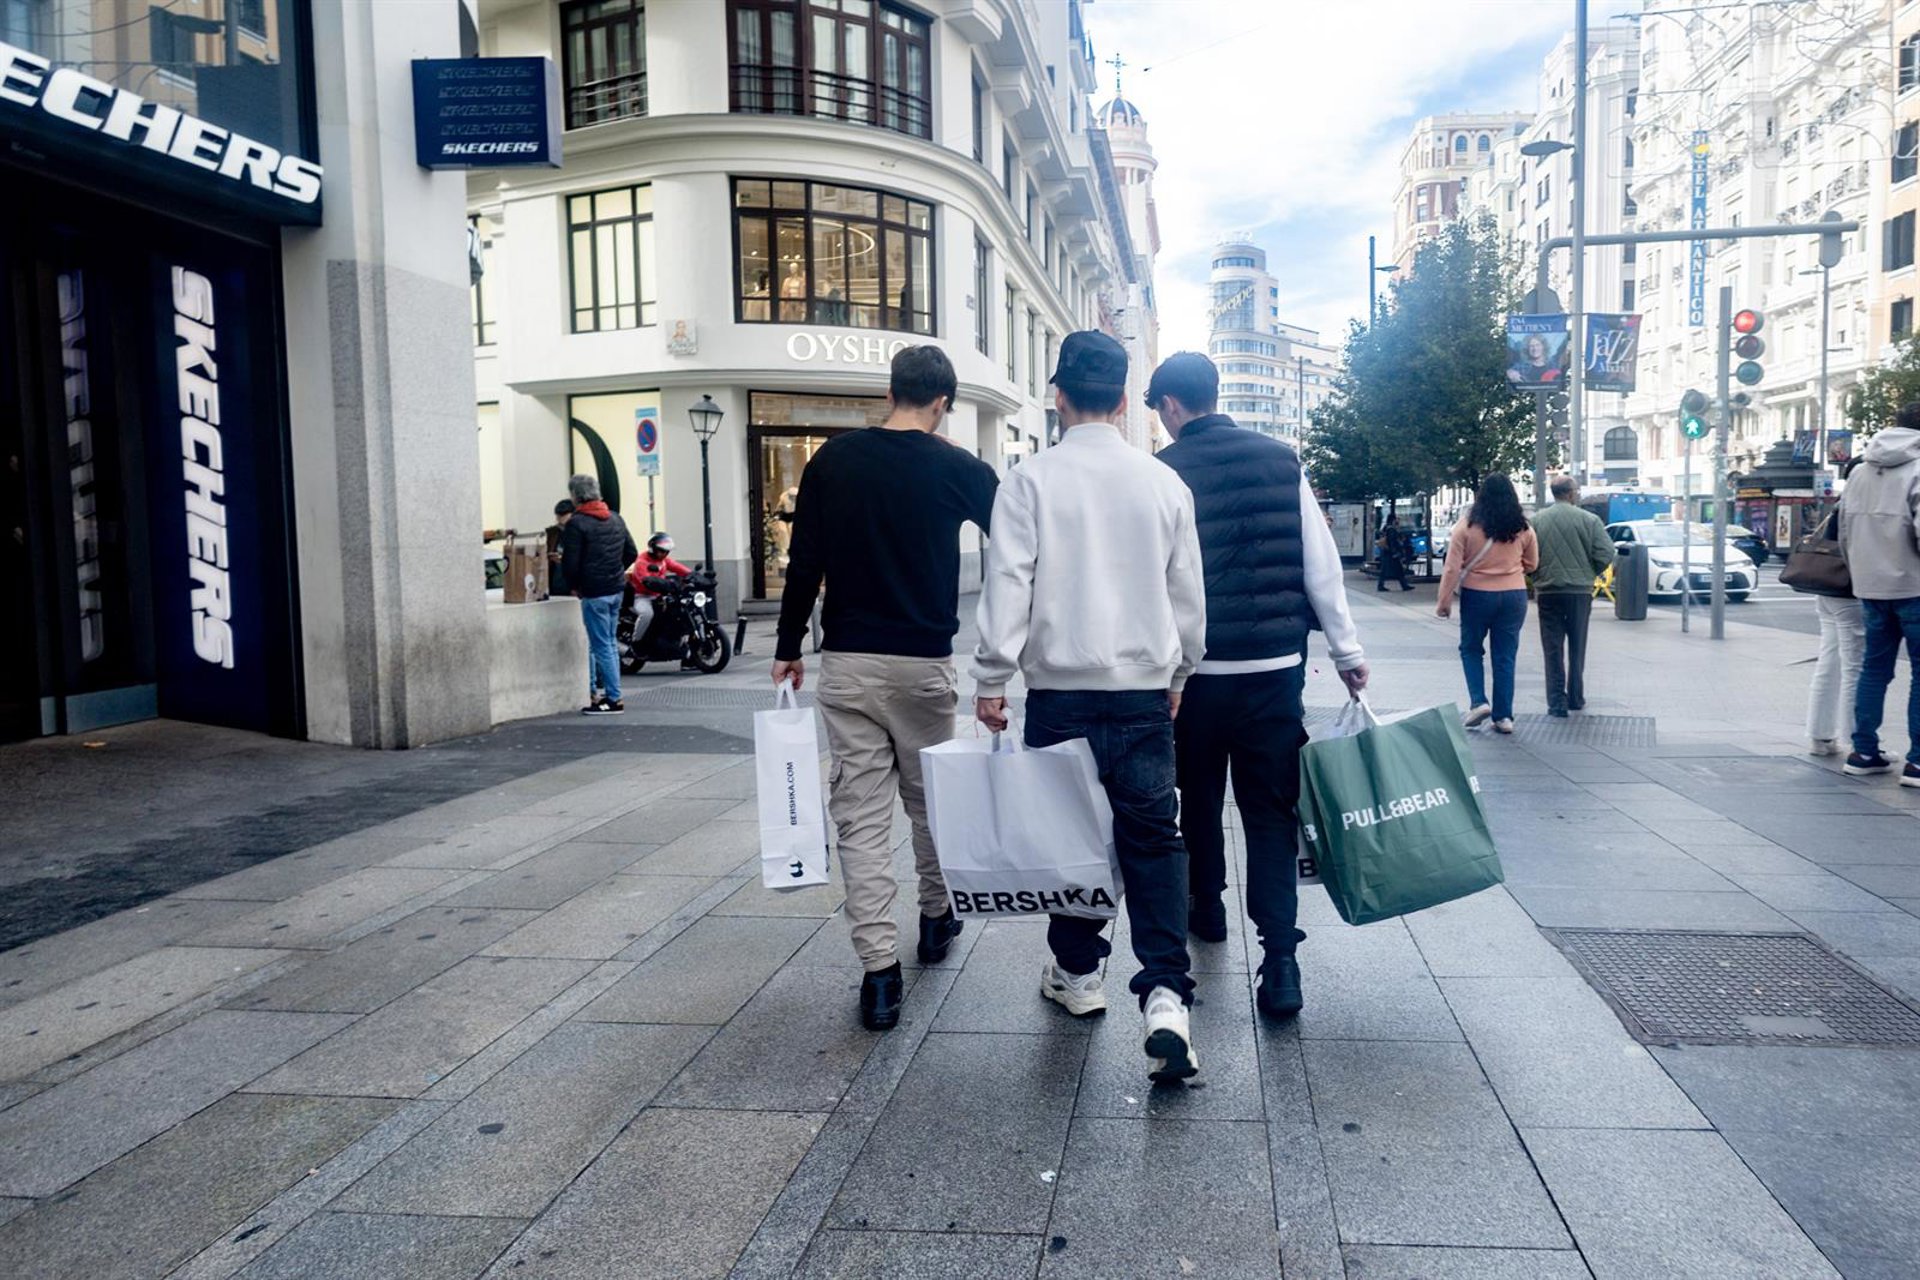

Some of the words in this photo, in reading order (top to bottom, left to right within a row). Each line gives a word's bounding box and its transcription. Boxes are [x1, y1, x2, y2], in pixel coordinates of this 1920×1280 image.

[441, 142, 540, 154] SKECHERS
[172, 265, 235, 669] SKECHERS
[787, 761, 797, 826] BERSHKA.COM
[1342, 787, 1450, 830] PULL&BEAR
[952, 887, 1116, 913] BERSHKA
